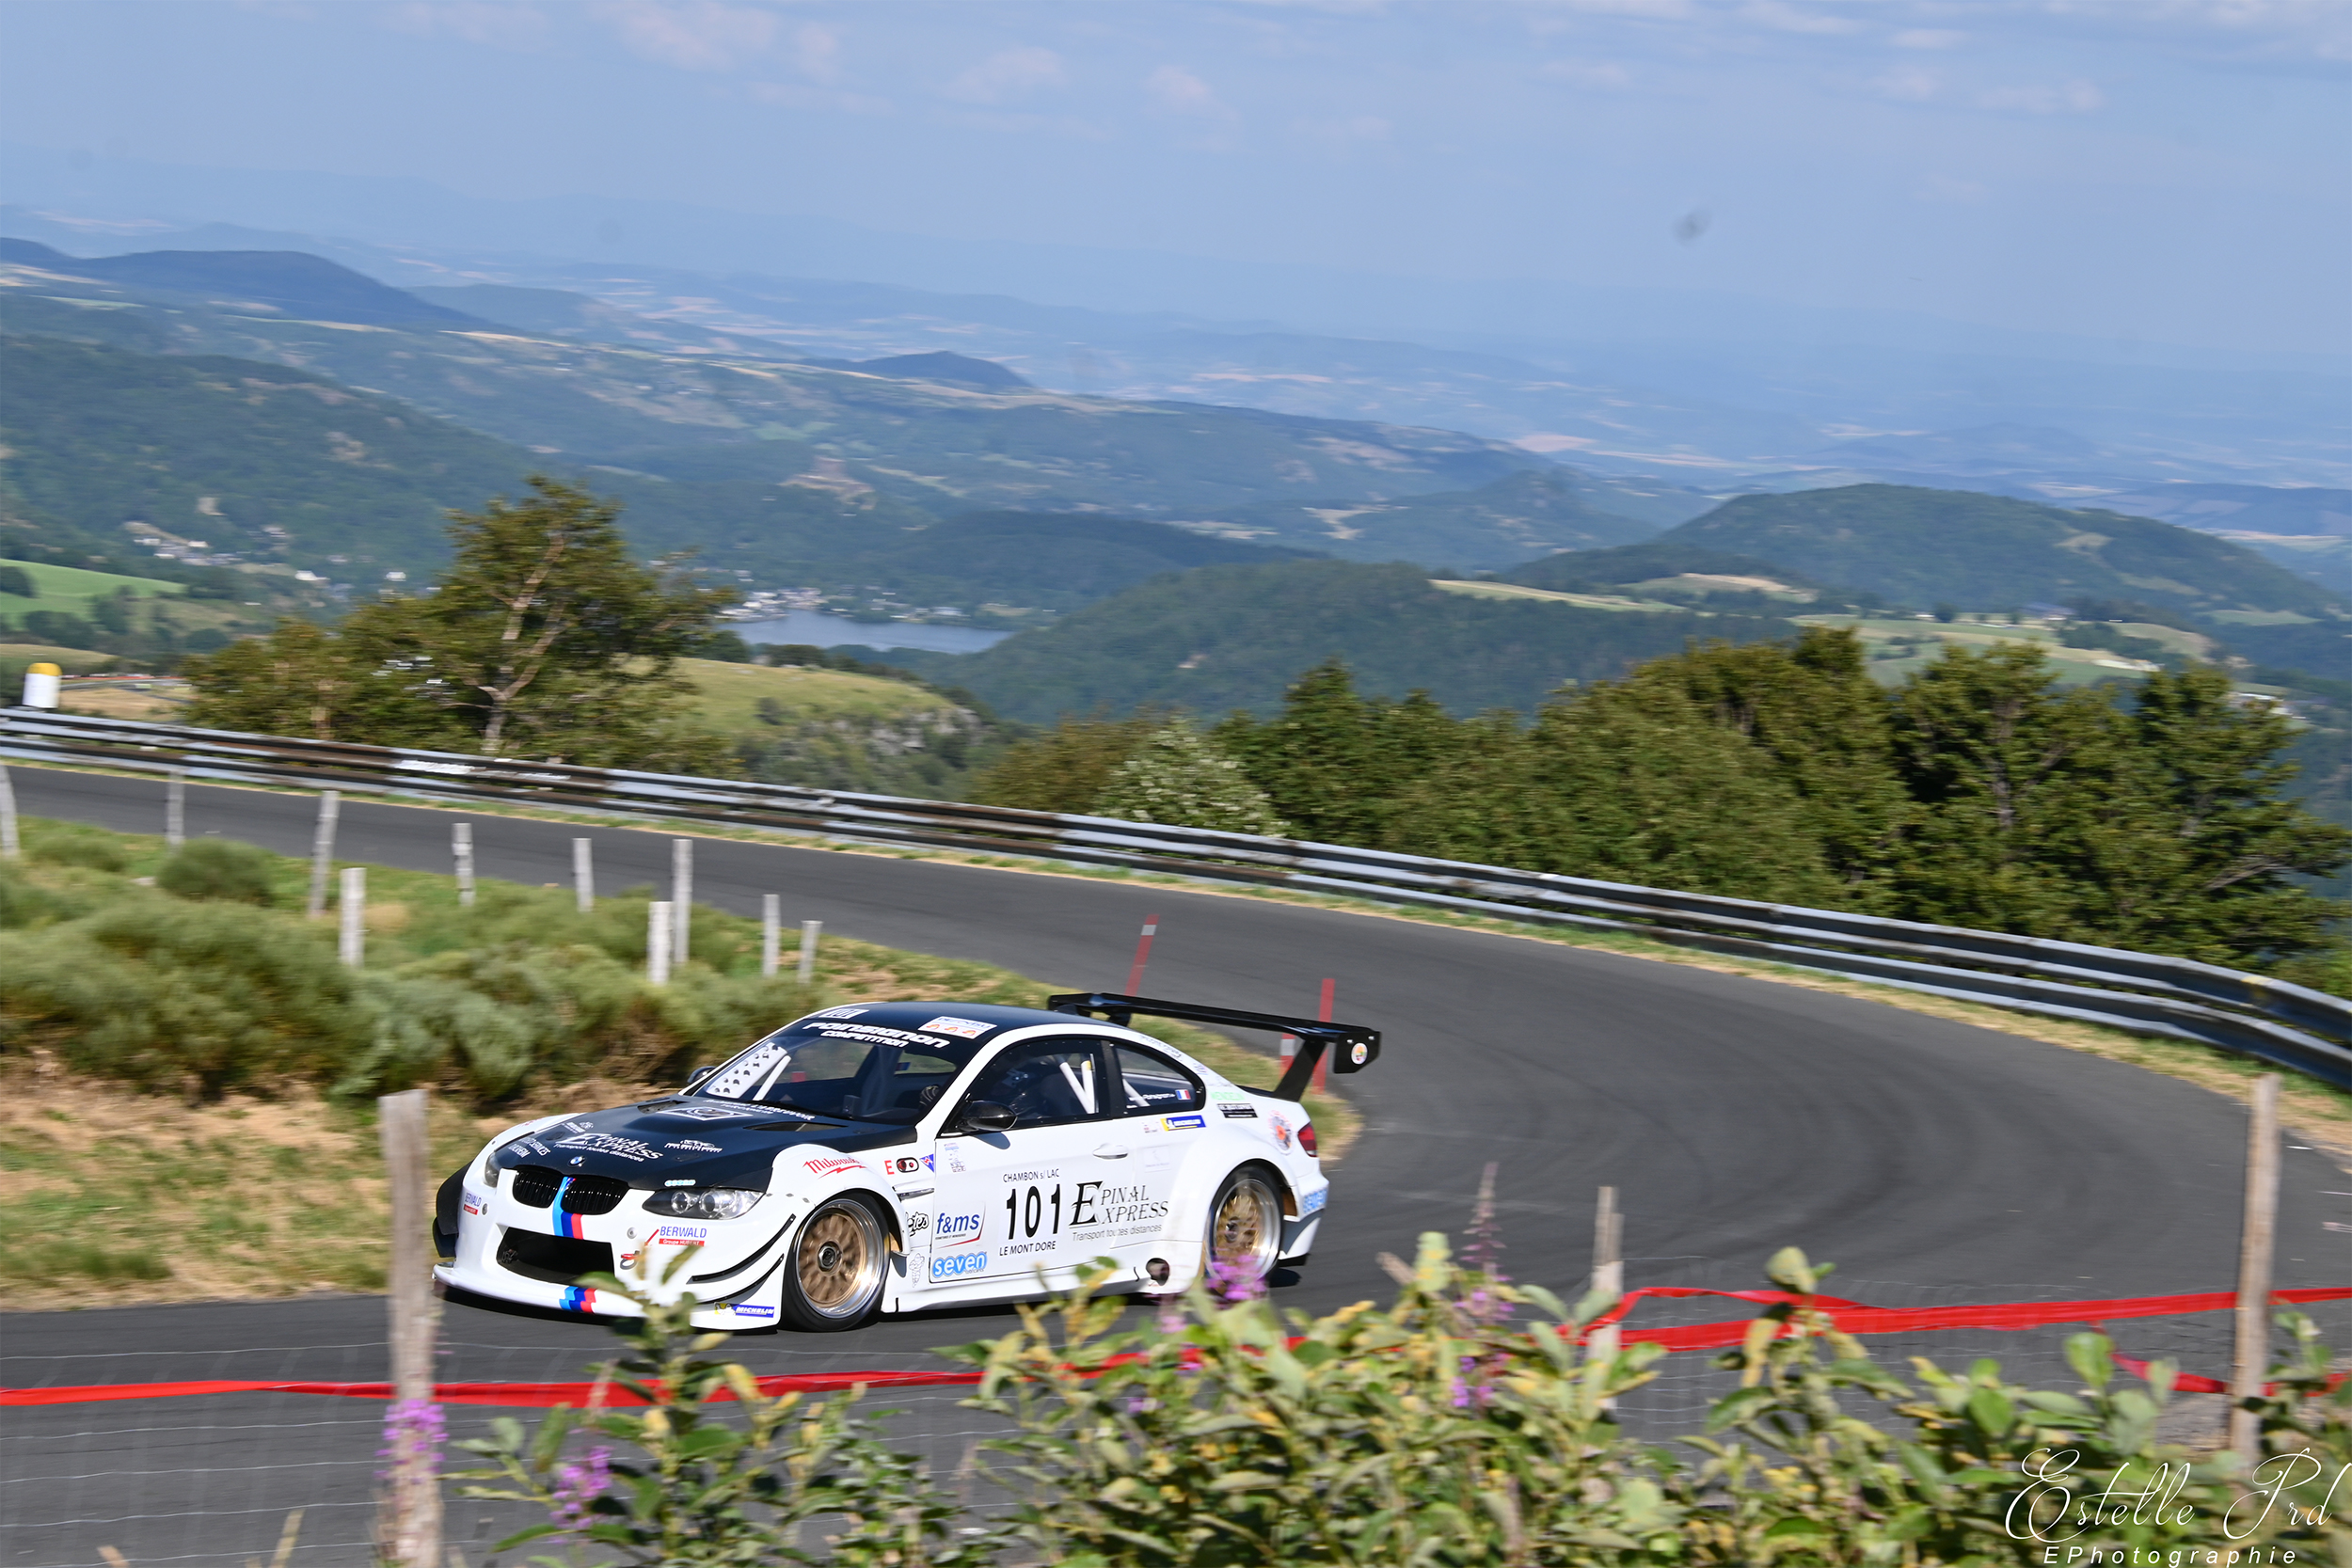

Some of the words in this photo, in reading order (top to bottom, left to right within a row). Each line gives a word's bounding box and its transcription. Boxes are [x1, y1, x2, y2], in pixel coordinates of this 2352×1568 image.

[803, 1022, 950, 1048] POINSIGNON
[820, 1030, 909, 1048] COMPETITION
[884, 1160, 895, 1175] E
[1003, 1170, 1039, 1182] CHAMBON
[1046, 1168, 1060, 1179] LAC
[1006, 1183, 1061, 1241] 101
[660, 1226, 707, 1238] BERWALD
[936, 1212, 980, 1234] f&ms
[1073, 1229, 1105, 1242] Transport
[1130, 1224, 1163, 1235] distances
[999, 1246, 1009, 1257] LE
[1009, 1243, 1035, 1256] MONT
[1035, 1240, 1057, 1253] DORE
[932, 1251, 987, 1278] seven
[736, 1307, 775, 1315] MICHELIN
